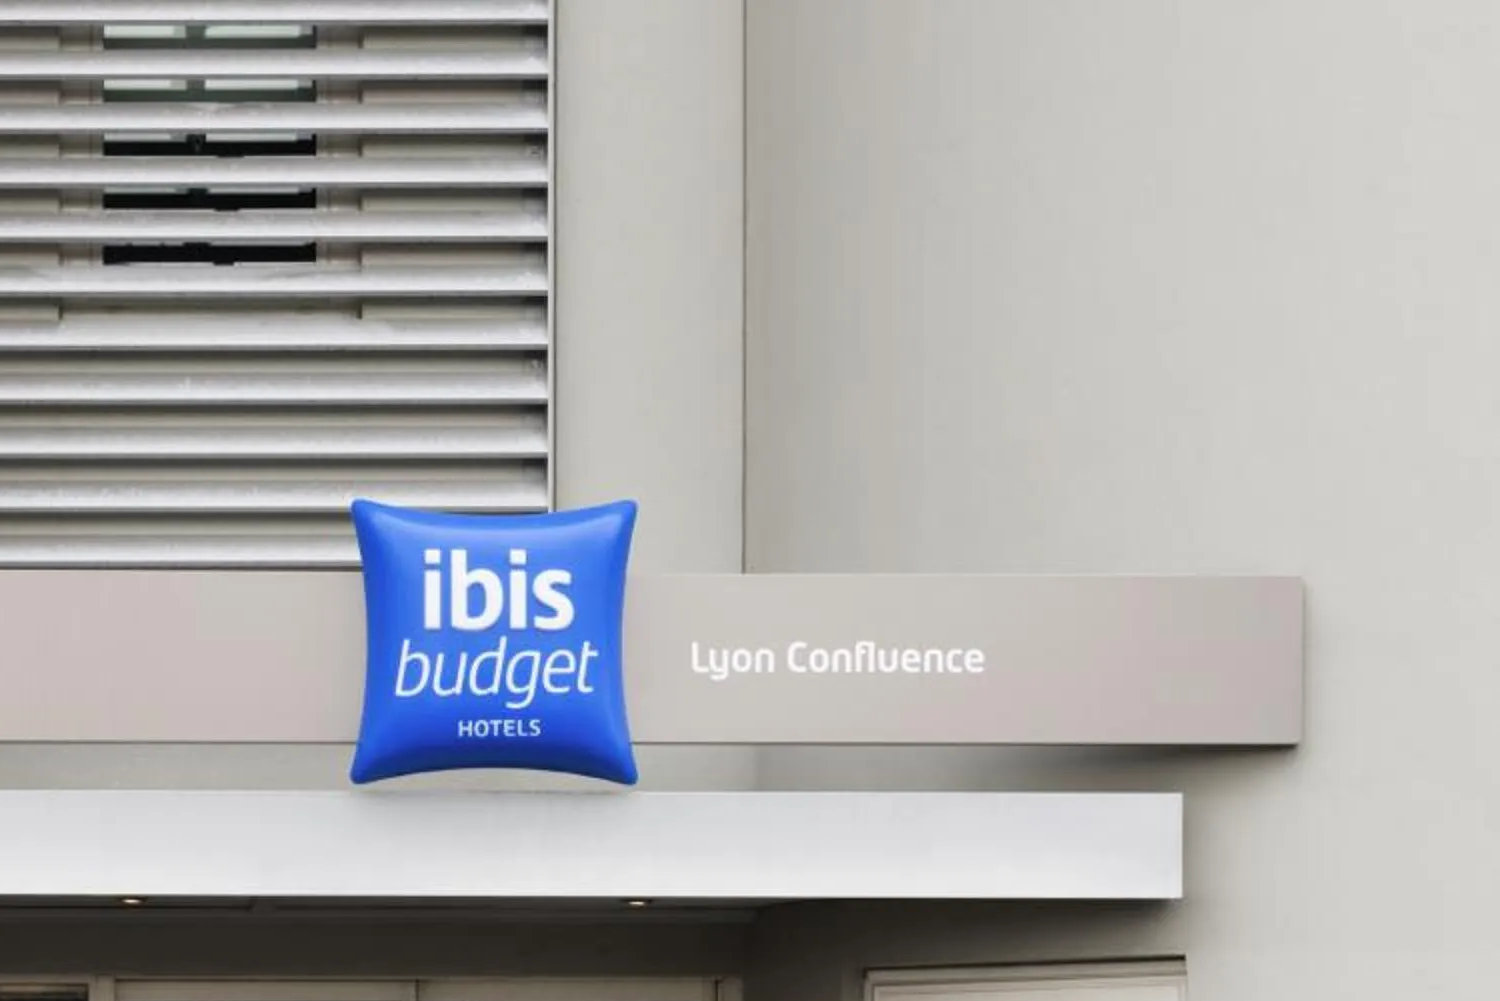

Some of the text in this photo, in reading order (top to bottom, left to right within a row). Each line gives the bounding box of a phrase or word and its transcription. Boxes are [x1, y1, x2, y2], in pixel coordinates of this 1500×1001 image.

[423, 548, 574, 631] ibis
[394, 635, 599, 709] budget
[690, 640, 986, 681] Lyon Confluence
[457, 719, 542, 738] HOTELS
